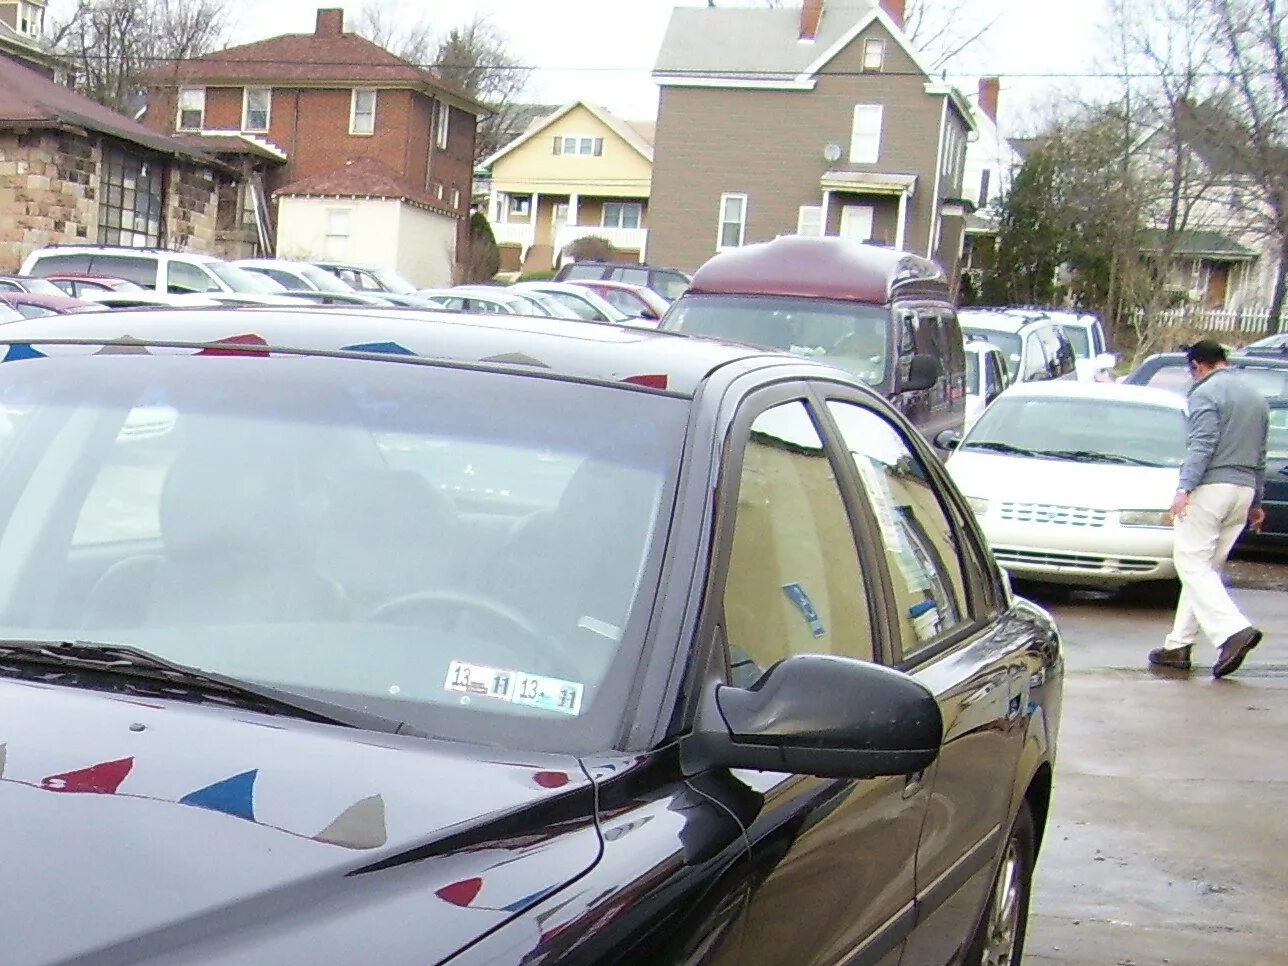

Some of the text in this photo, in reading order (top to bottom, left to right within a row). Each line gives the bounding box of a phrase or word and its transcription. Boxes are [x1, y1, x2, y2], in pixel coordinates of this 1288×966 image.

[451, 666, 471, 687] 13
[493, 675, 510, 695] 11
[520, 678, 539, 699] 13
